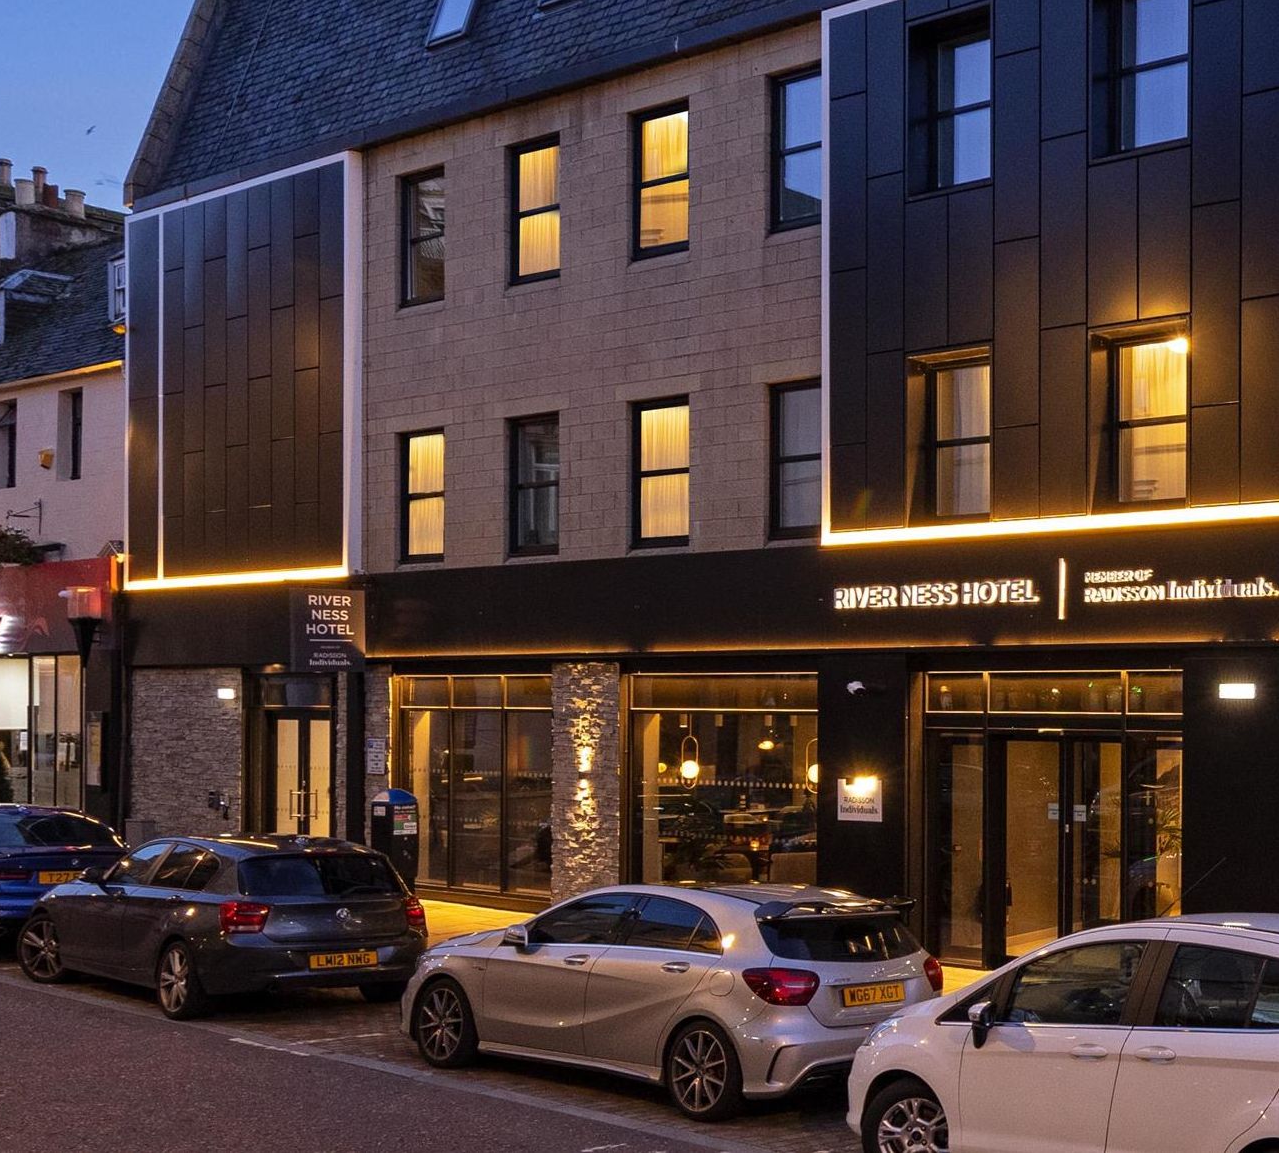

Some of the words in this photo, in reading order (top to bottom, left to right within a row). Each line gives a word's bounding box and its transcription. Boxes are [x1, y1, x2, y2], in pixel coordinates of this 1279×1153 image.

[308, 595, 352, 607] RIVER
[834, 586, 898, 610] RIVER
[900, 582, 958, 608] NESS
[962, 579, 1040, 605] HOTEL
[1084, 585, 1165, 603] RADISSON
[311, 609, 349, 621] NESS
[306, 623, 355, 635] HOTEL
[879, 985, 899, 1001] XGT
